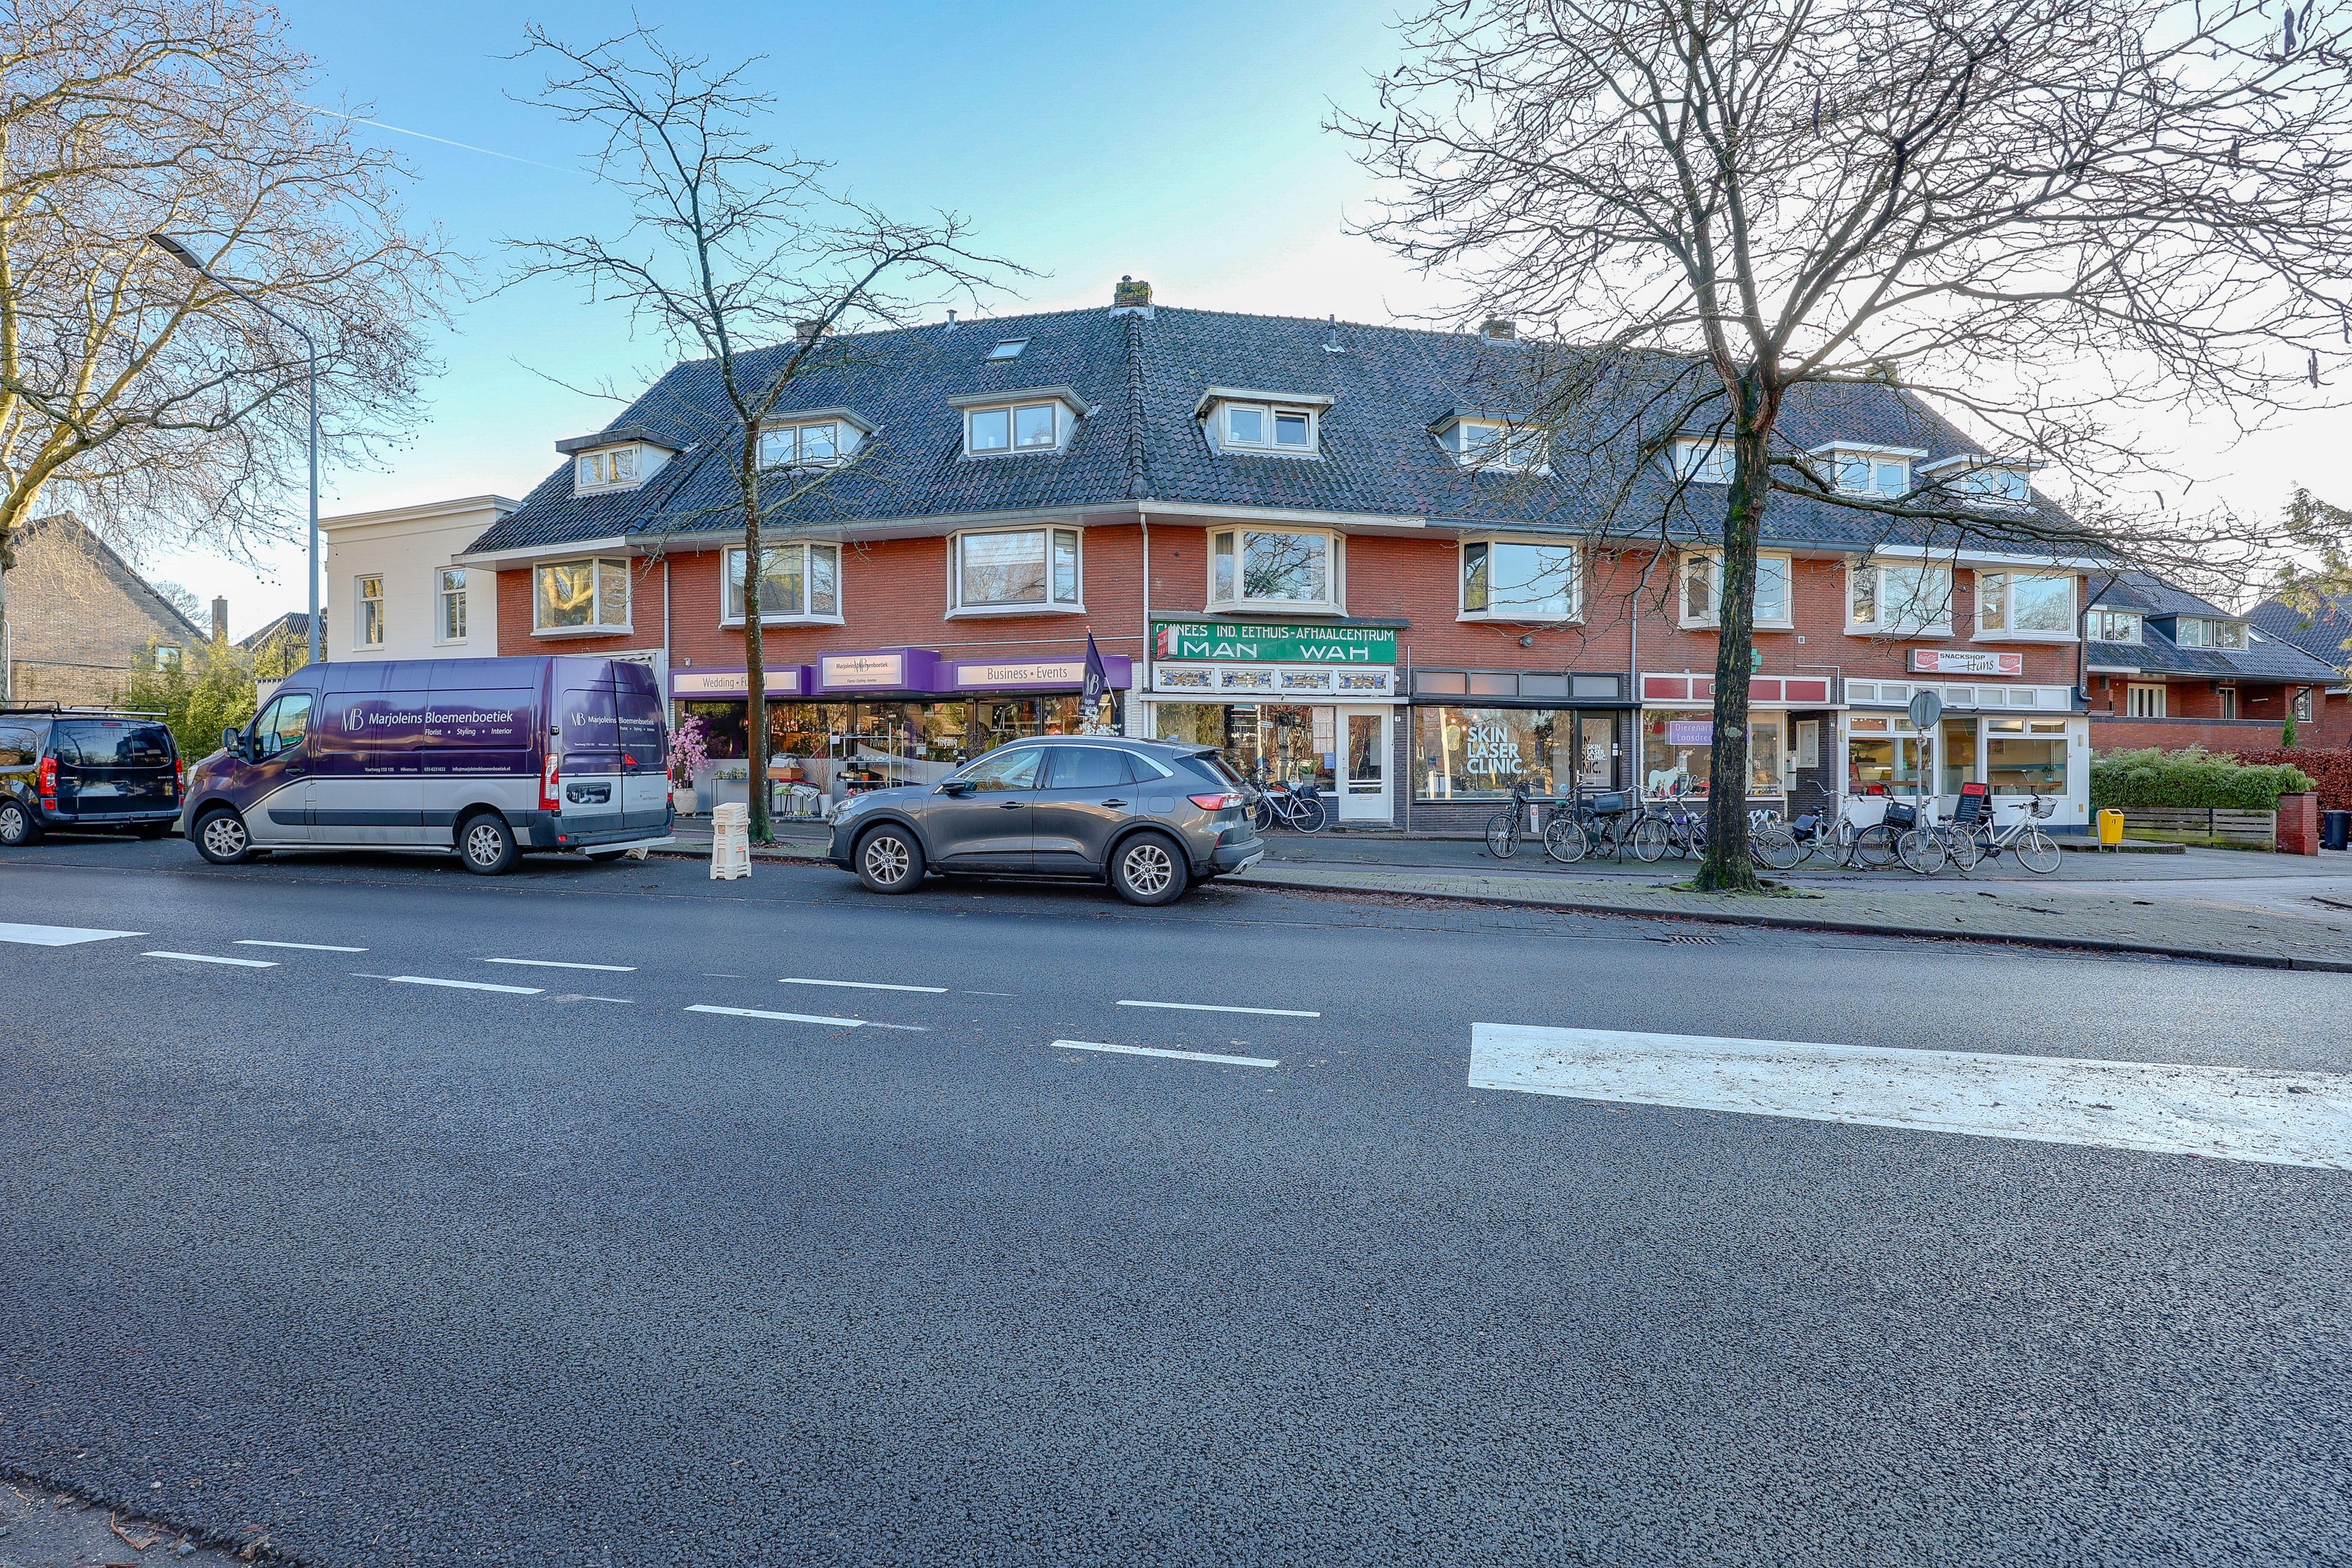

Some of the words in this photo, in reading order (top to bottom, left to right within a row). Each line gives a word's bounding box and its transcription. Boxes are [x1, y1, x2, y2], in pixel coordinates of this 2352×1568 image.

[1217, 626, 1238, 638] IND.
[1184, 641, 1257, 658] MAN
[1299, 645, 1368, 660] WAH
[1958, 655, 1994, 671] Hans
[987, 667, 1028, 680] Business
[1037, 666, 1067, 678] Events
[703, 677, 734, 689] Wedding
[341, 708, 364, 733] MB
[369, 711, 423, 727] Marjoleins
[425, 710, 514, 724] Bloemenboetiek
[588, 716, 617, 725] Marjoleins
[619, 717, 655, 726] Bloemenboetiek
[456, 728, 476, 736] Styling
[1467, 727, 1508, 742] SKIN
[937, 738, 958, 749] Ingang
[1467, 743, 1520, 758] LASER
[1466, 758, 1527, 774] CLINIC.
